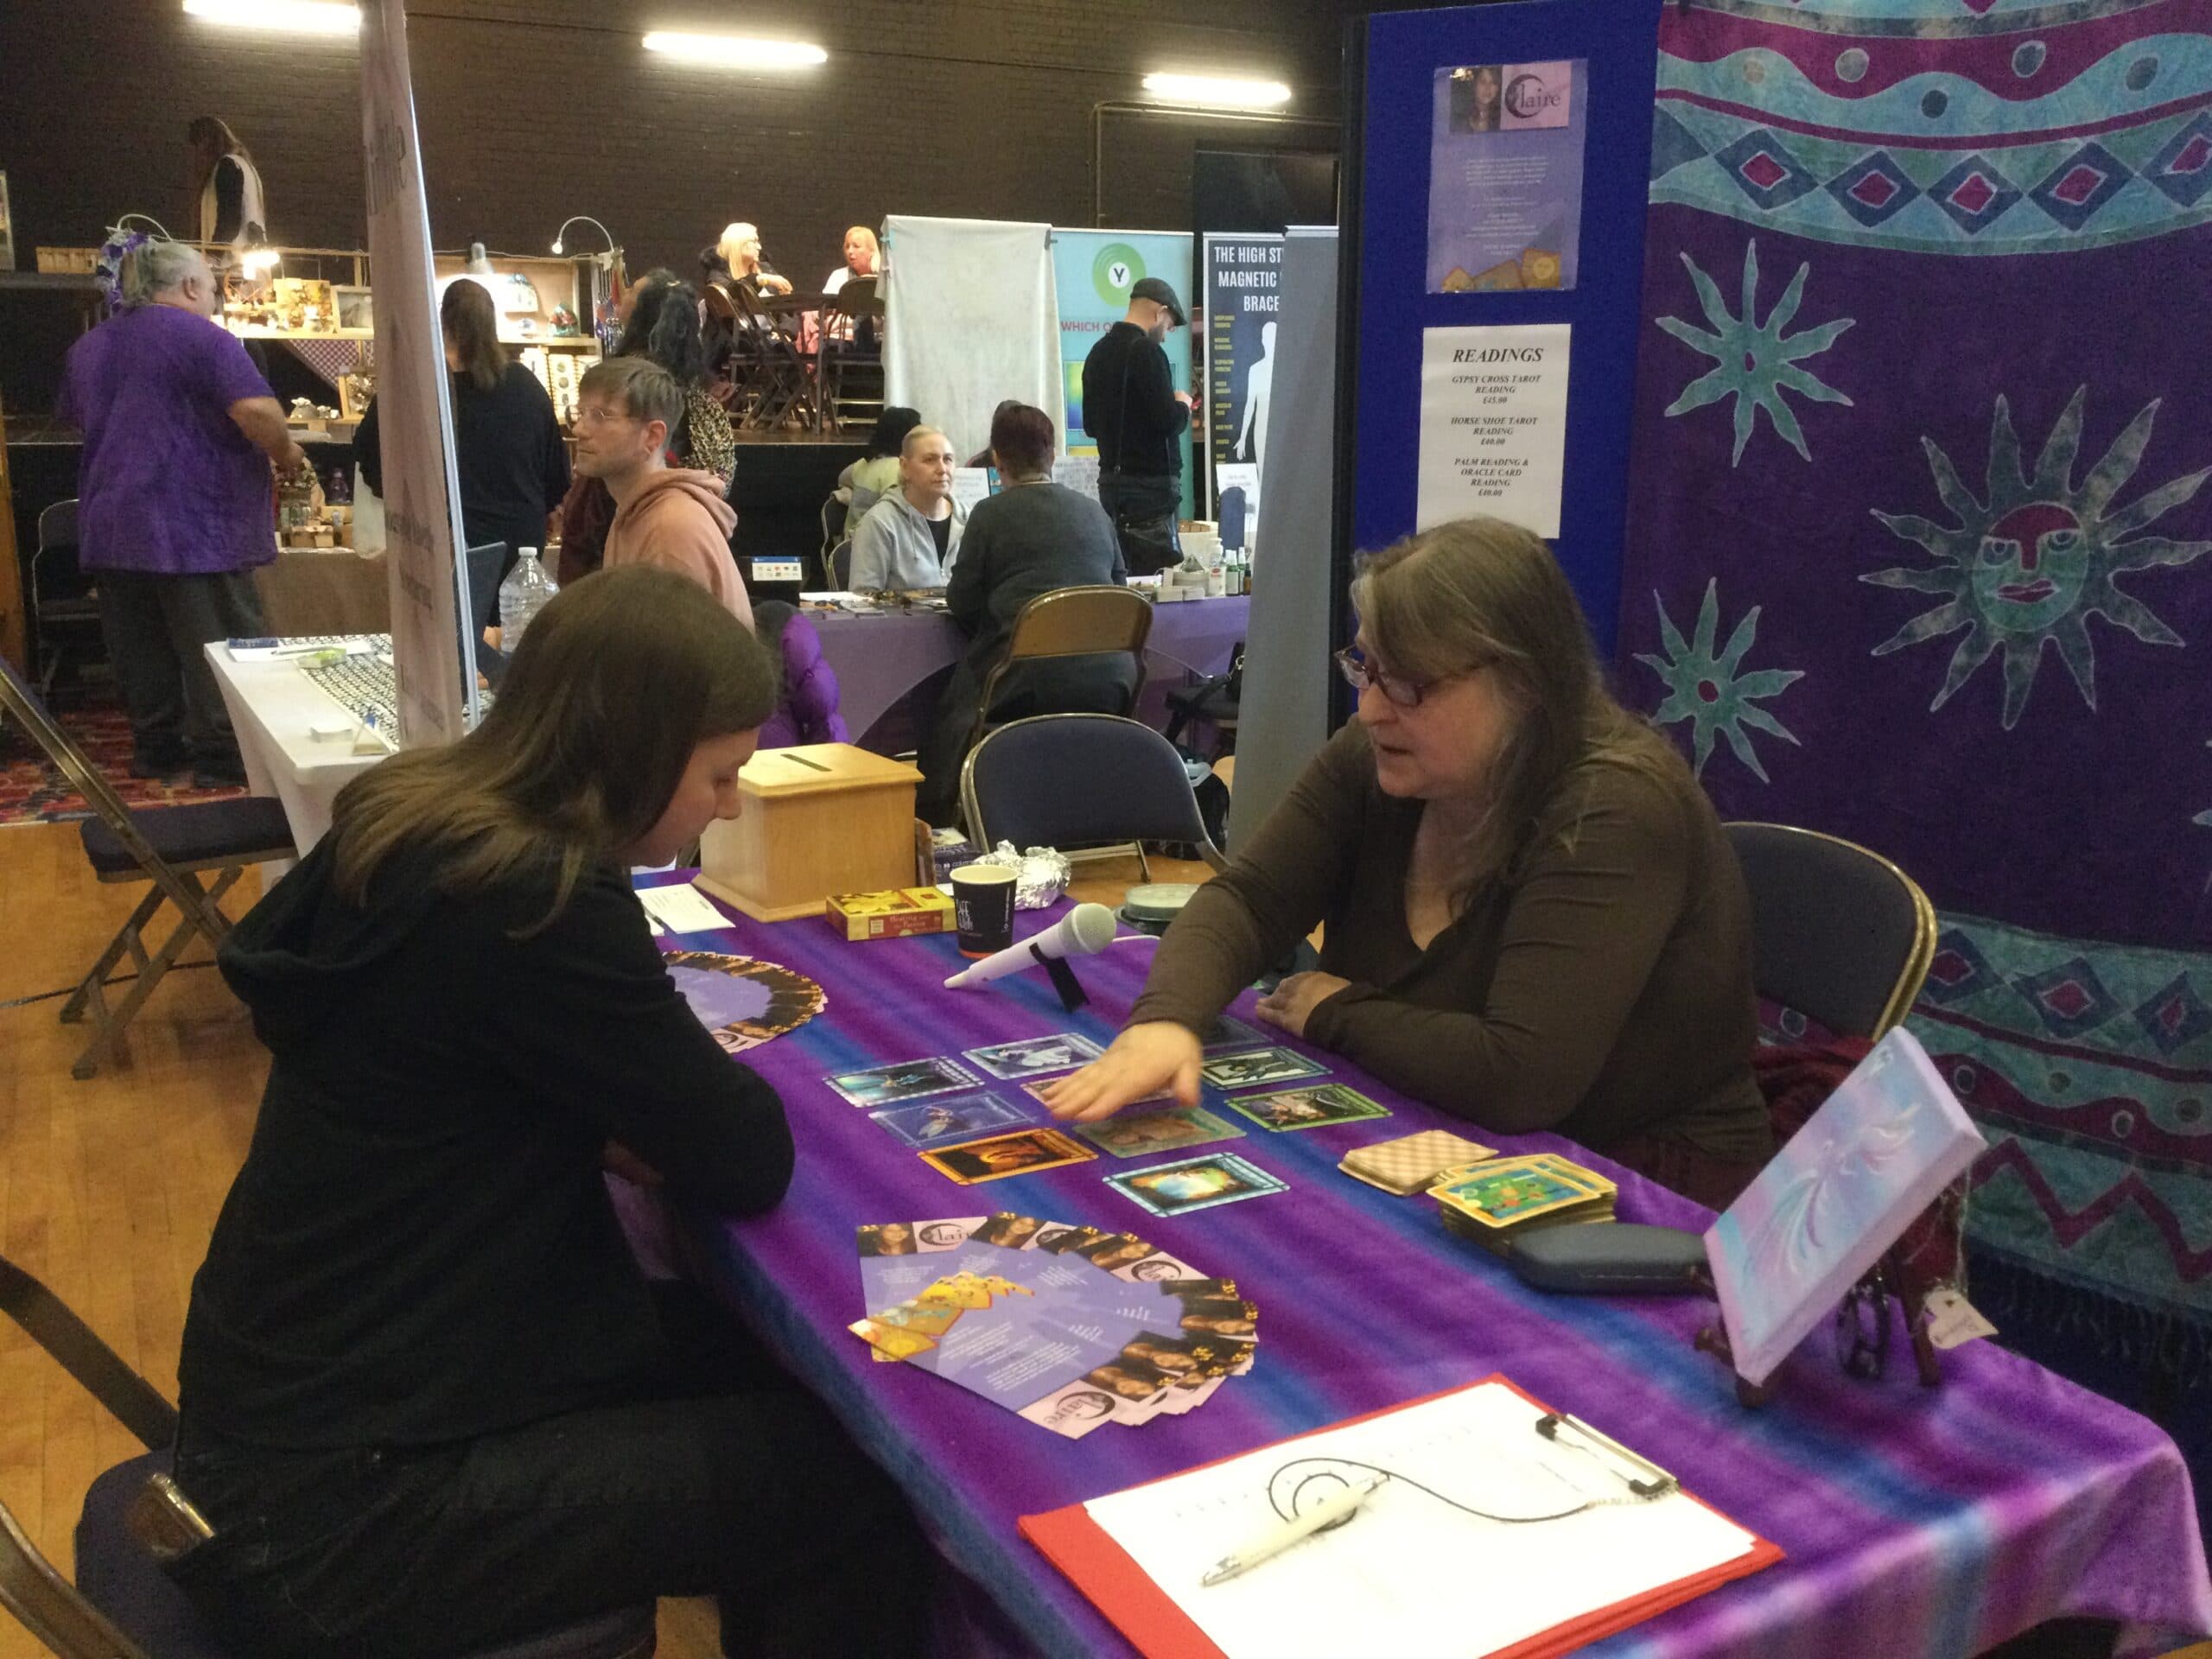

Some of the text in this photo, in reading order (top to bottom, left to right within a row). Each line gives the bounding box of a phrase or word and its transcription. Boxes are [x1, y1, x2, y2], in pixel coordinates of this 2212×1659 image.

[1214, 246, 1285, 264] THE HIGH ST
[1113, 266, 1126, 283] Y
[1217, 270, 1277, 288] MAGNETIC
[1060, 321, 1100, 333] WHICH
[1452, 347, 1544, 363] READINGS
[1452, 375, 1479, 384] GYPSY
[1512, 374, 1541, 383] TAROT
[1475, 385, 1516, 394] READING
[1473, 427, 1514, 435] READING
[1480, 437, 1505, 446] £40.00
[1454, 458, 1529, 467] PALM READING &
[1460, 468, 1522, 477] ORACLE CARD
[1471, 479, 1510, 487] READING
